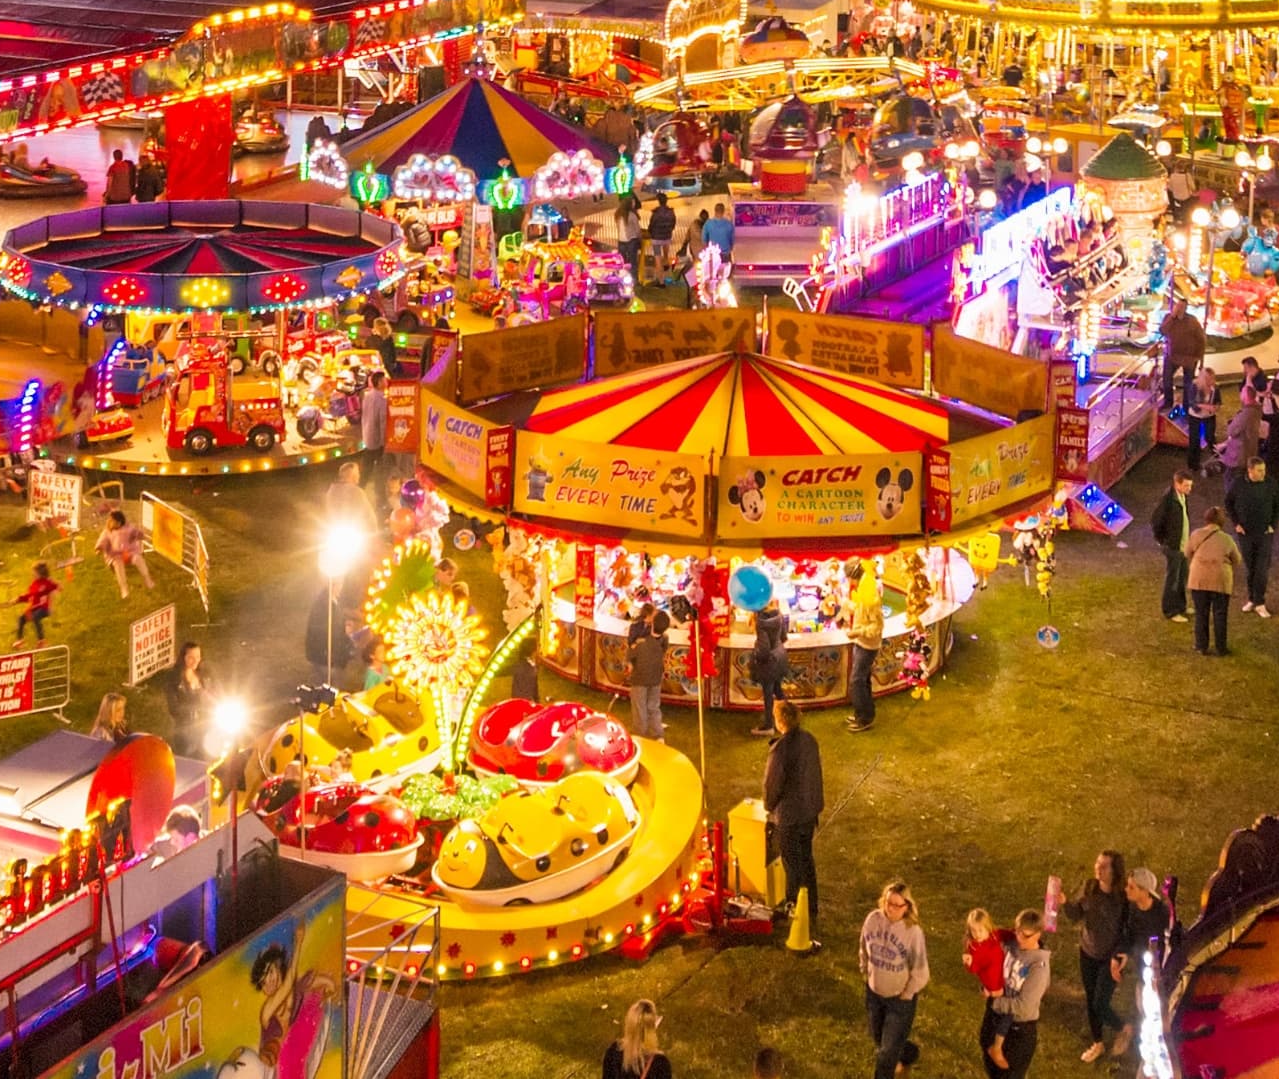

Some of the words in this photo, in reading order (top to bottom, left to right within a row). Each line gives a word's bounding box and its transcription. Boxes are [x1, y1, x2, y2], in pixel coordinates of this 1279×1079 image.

[445, 417, 484, 441] CATCH
[1060, 436, 1087, 448] FAMILY
[33, 473, 76, 490] SAFETY
[561, 458, 600, 486] Any
[610, 459, 658, 489] Prize
[782, 464, 863, 487] CATCH
[555, 486, 611, 508] EVERY
[619, 494, 658, 514] TIME
[782, 489, 790, 499] A
[796, 489, 865, 499] CARTOON
[967, 481, 1001, 505] EVERY
[776, 500, 866, 511] CHARACTER
[776, 511, 792, 523] TO
[794, 512, 816, 524] WIN
[135, 610, 172, 638] SAFETY
[135, 625, 171, 652] NOTICE
[135, 648, 155, 663] STAND
[157, 639, 173, 652] BACK
[0, 657, 31, 673] STAND
[4, 686, 15, 699] IS
